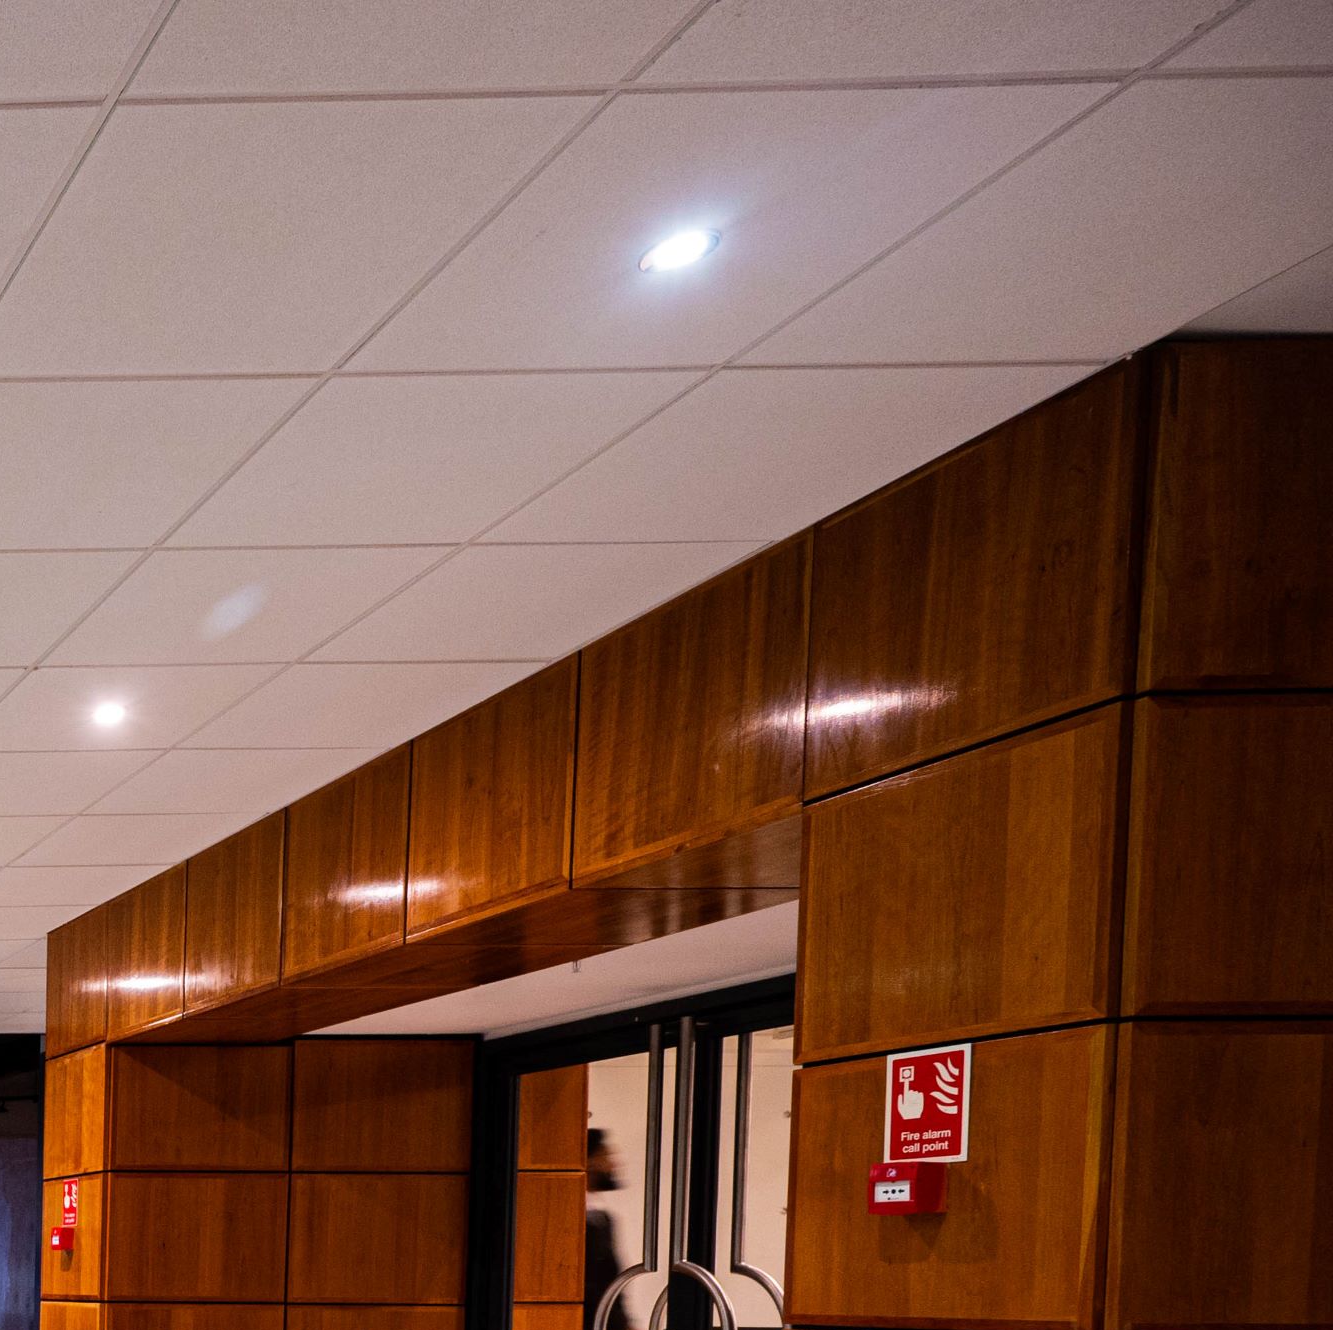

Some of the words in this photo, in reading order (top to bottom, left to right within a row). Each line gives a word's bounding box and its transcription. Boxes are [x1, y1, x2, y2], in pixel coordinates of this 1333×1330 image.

[901, 1131, 920, 1141] Fire
[922, 1130, 951, 1139] alarm
[902, 1143, 920, 1153] call
[922, 1141, 949, 1154] point
